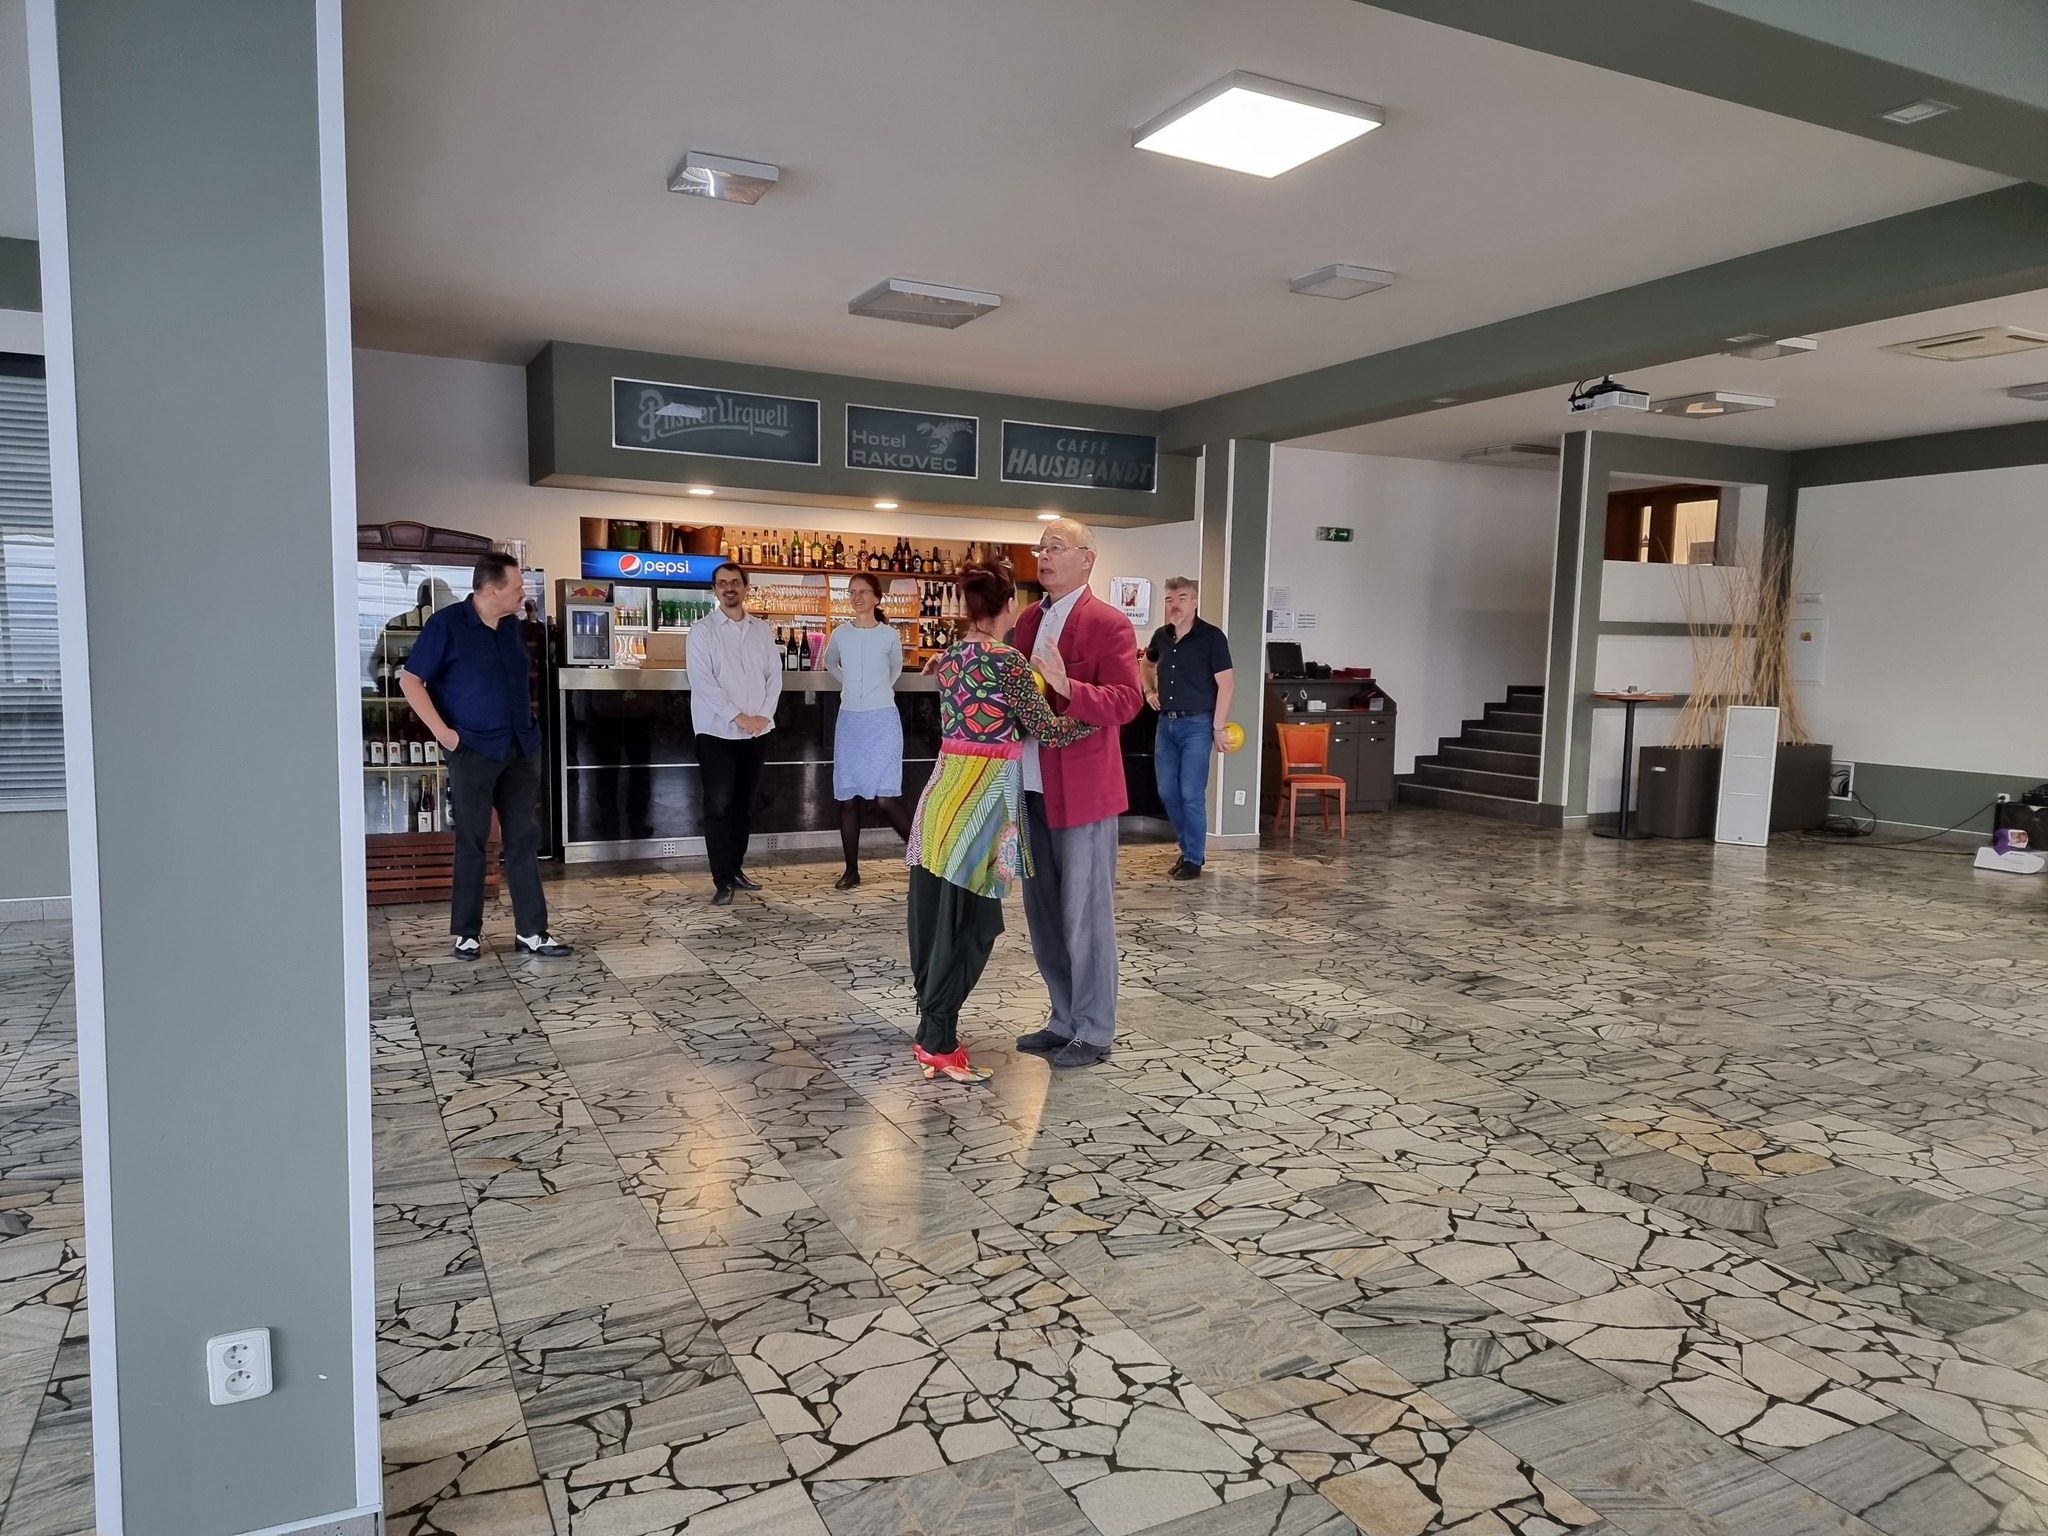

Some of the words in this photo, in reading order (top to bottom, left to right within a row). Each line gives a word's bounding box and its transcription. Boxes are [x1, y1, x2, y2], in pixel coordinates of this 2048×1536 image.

[715, 393, 788, 436] Urquell
[852, 430, 906, 448] Hotel
[852, 449, 957, 472] RAKOVEC
[1006, 447, 1152, 483] HAUSBRANDT
[644, 560, 689, 576] pepsi
